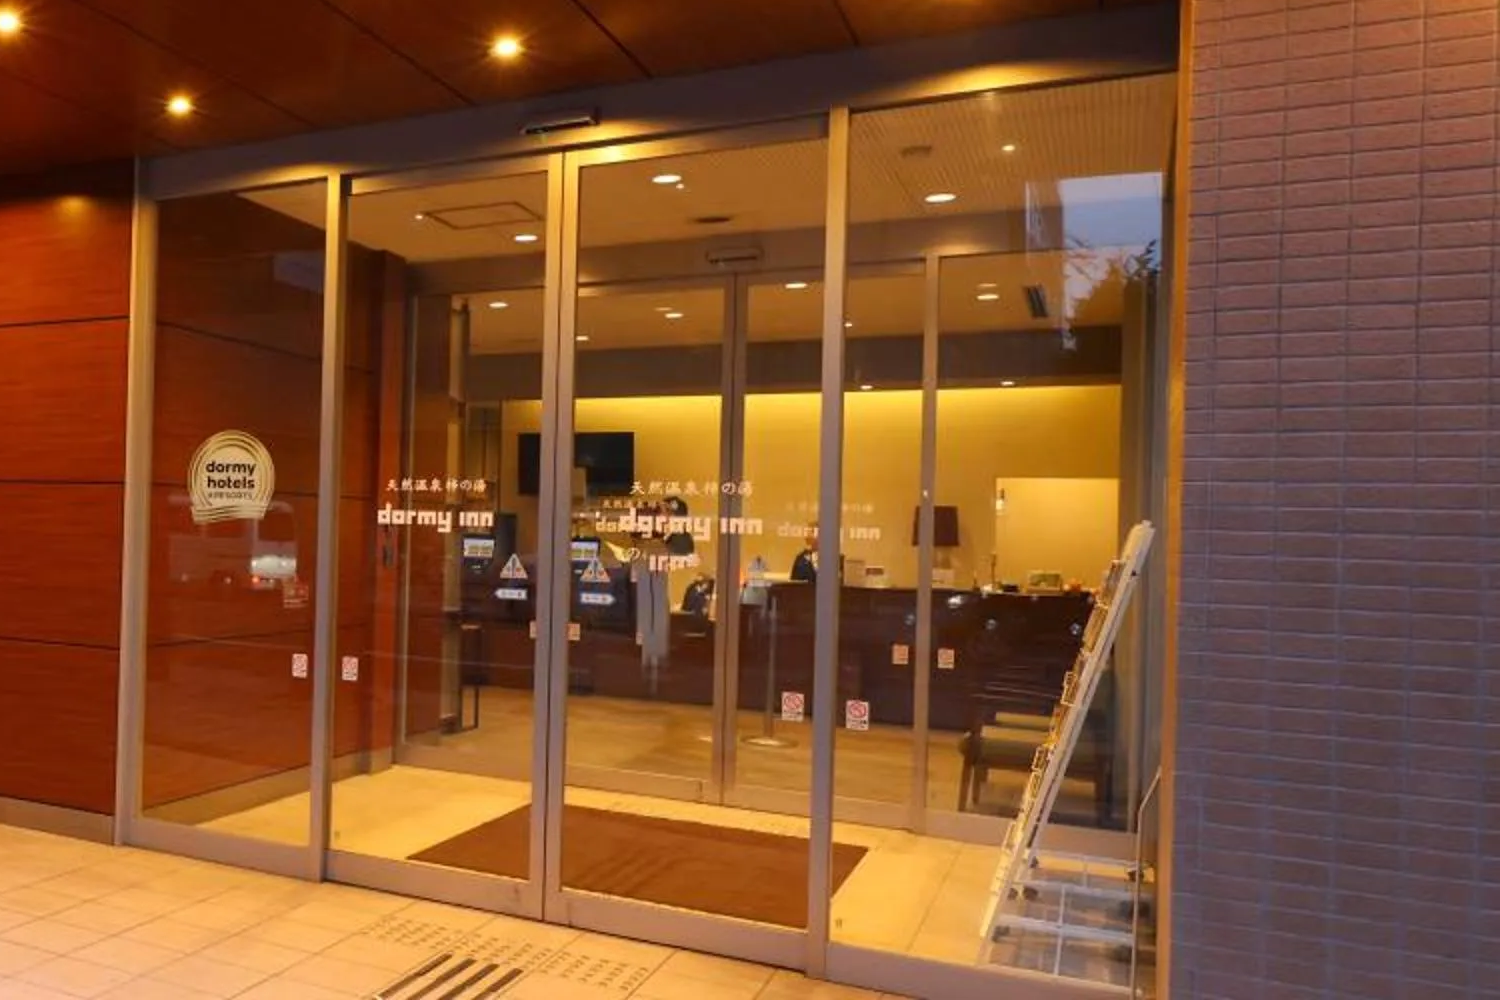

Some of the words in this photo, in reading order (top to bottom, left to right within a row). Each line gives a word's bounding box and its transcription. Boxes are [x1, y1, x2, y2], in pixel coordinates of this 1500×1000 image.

[205, 460, 257, 477] dormy
[207, 476, 256, 489] hotels
[377, 502, 453, 533] dormy
[459, 511, 495, 527] inn
[720, 517, 764, 535] inn
